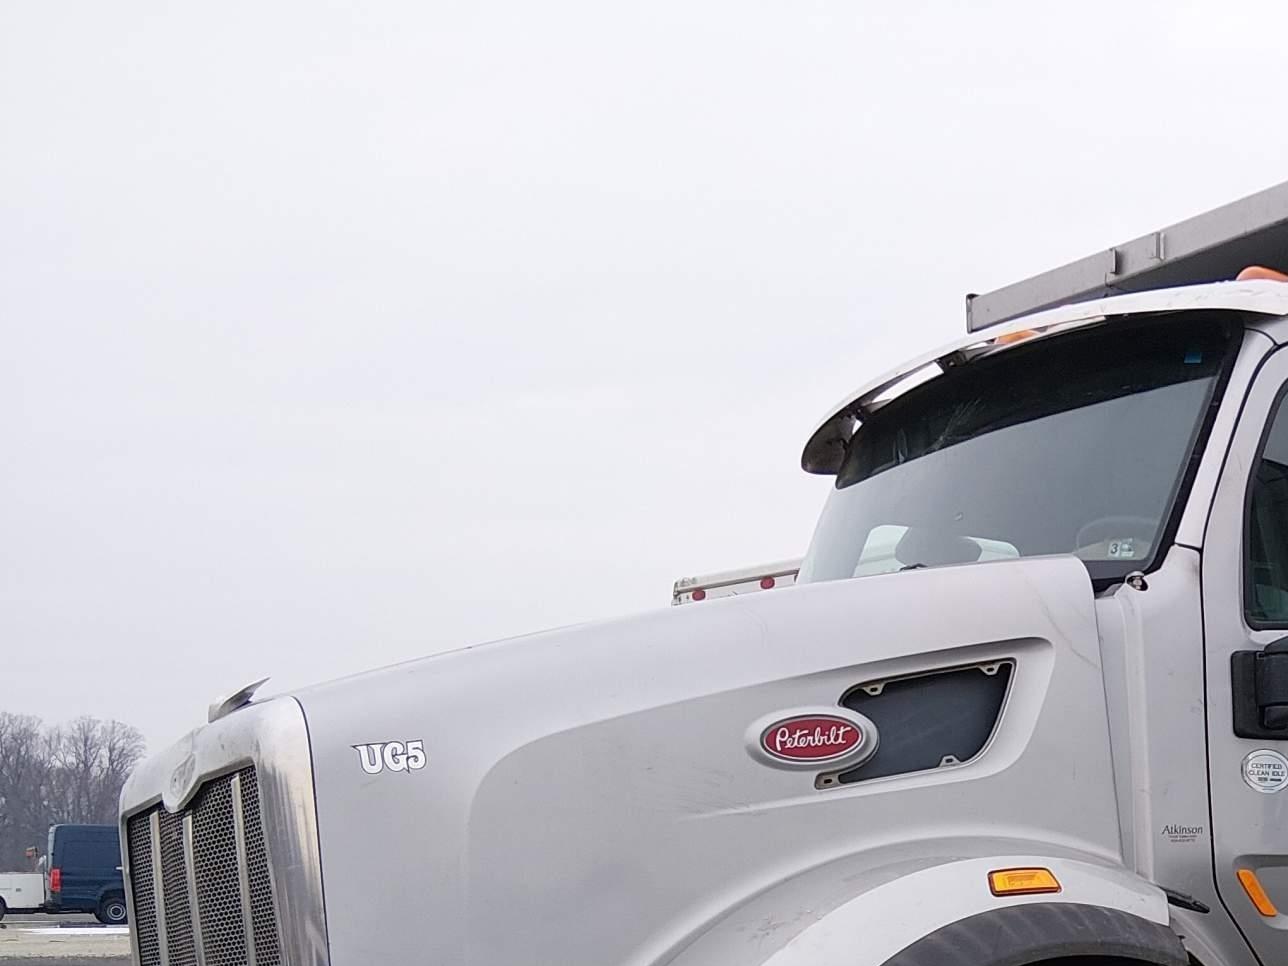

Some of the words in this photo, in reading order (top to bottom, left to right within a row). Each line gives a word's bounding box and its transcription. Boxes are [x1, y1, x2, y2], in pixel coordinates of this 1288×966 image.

[775, 725, 852, 751] Peterbilt
[350, 739, 427, 775] UG5
[1161, 824, 1203, 835] Atkinson
